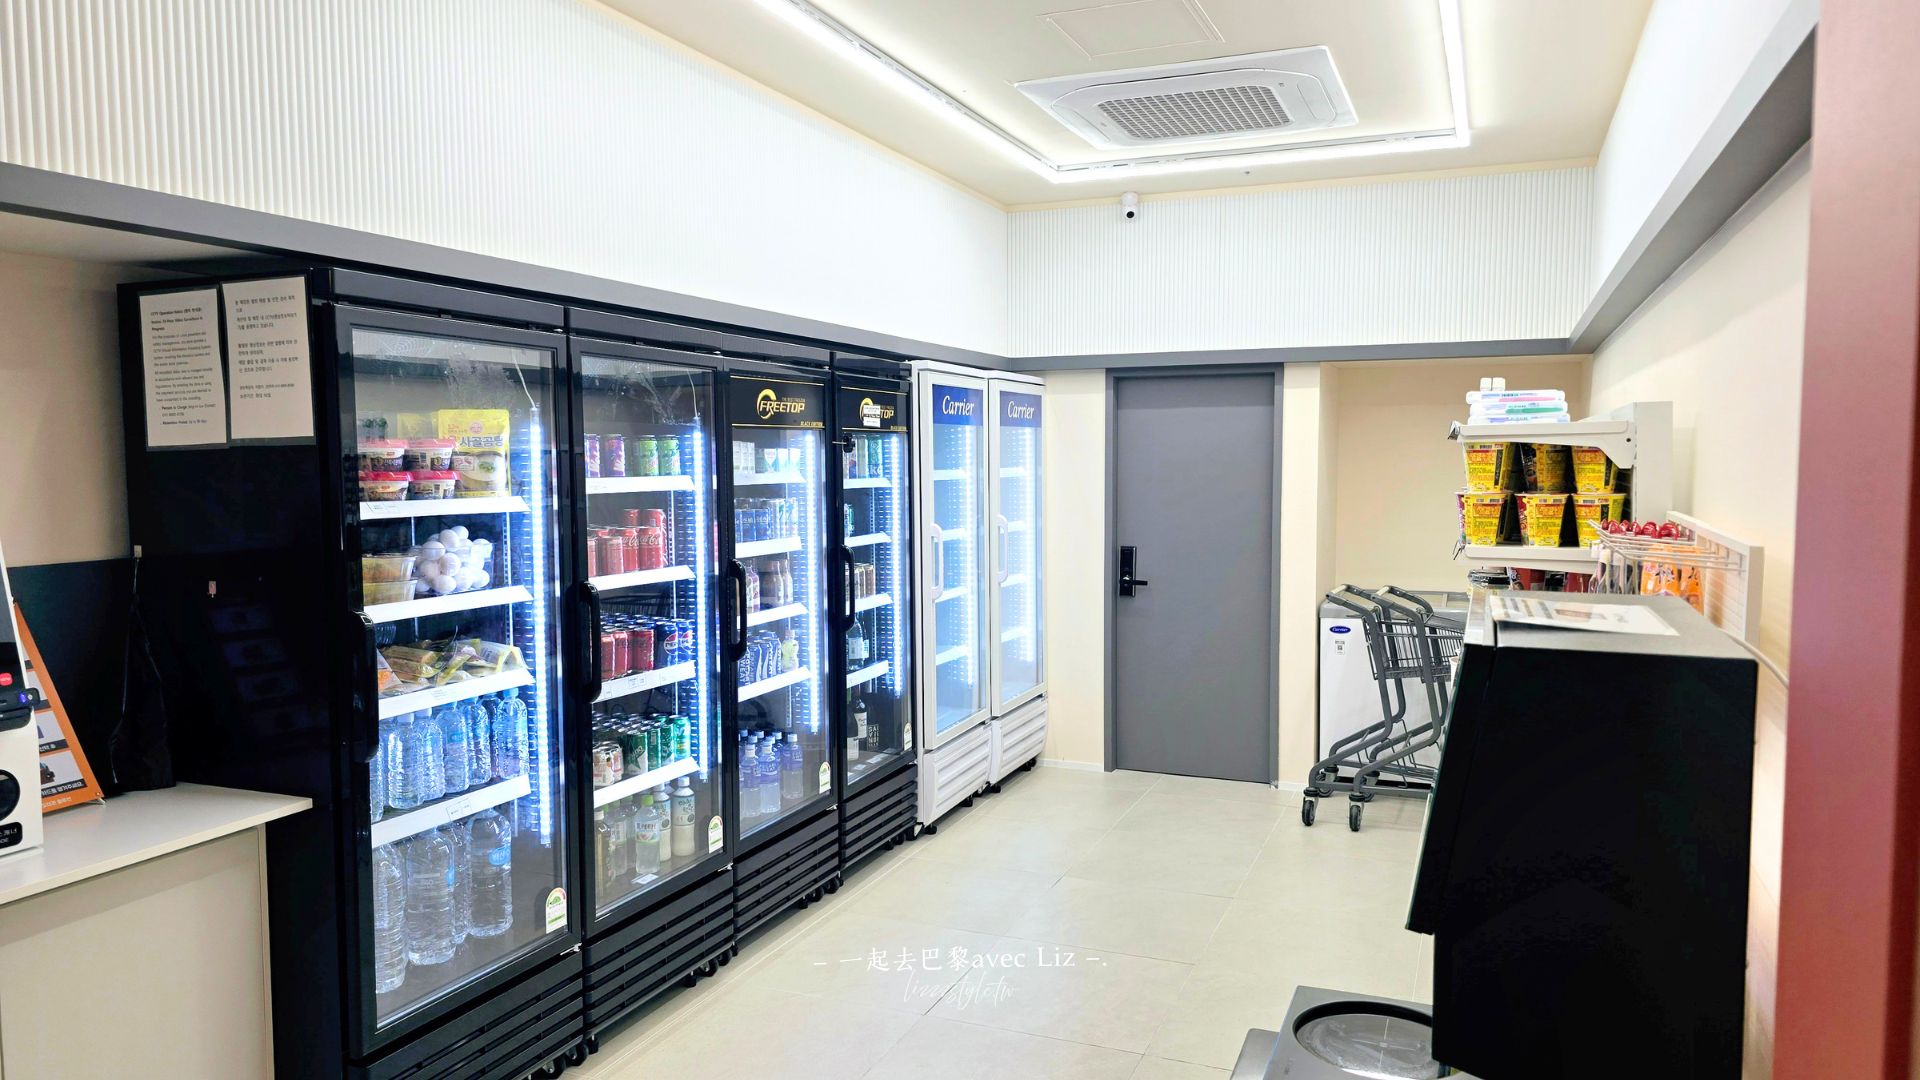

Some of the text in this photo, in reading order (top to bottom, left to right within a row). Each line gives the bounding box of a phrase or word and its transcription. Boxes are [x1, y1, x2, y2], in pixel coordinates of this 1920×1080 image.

[759, 400, 806, 416] FREETOP
[942, 395, 975, 416] Carrier
[1007, 401, 1035, 419] Carrier
[460, 436, 503, 448] 사골곰탕
